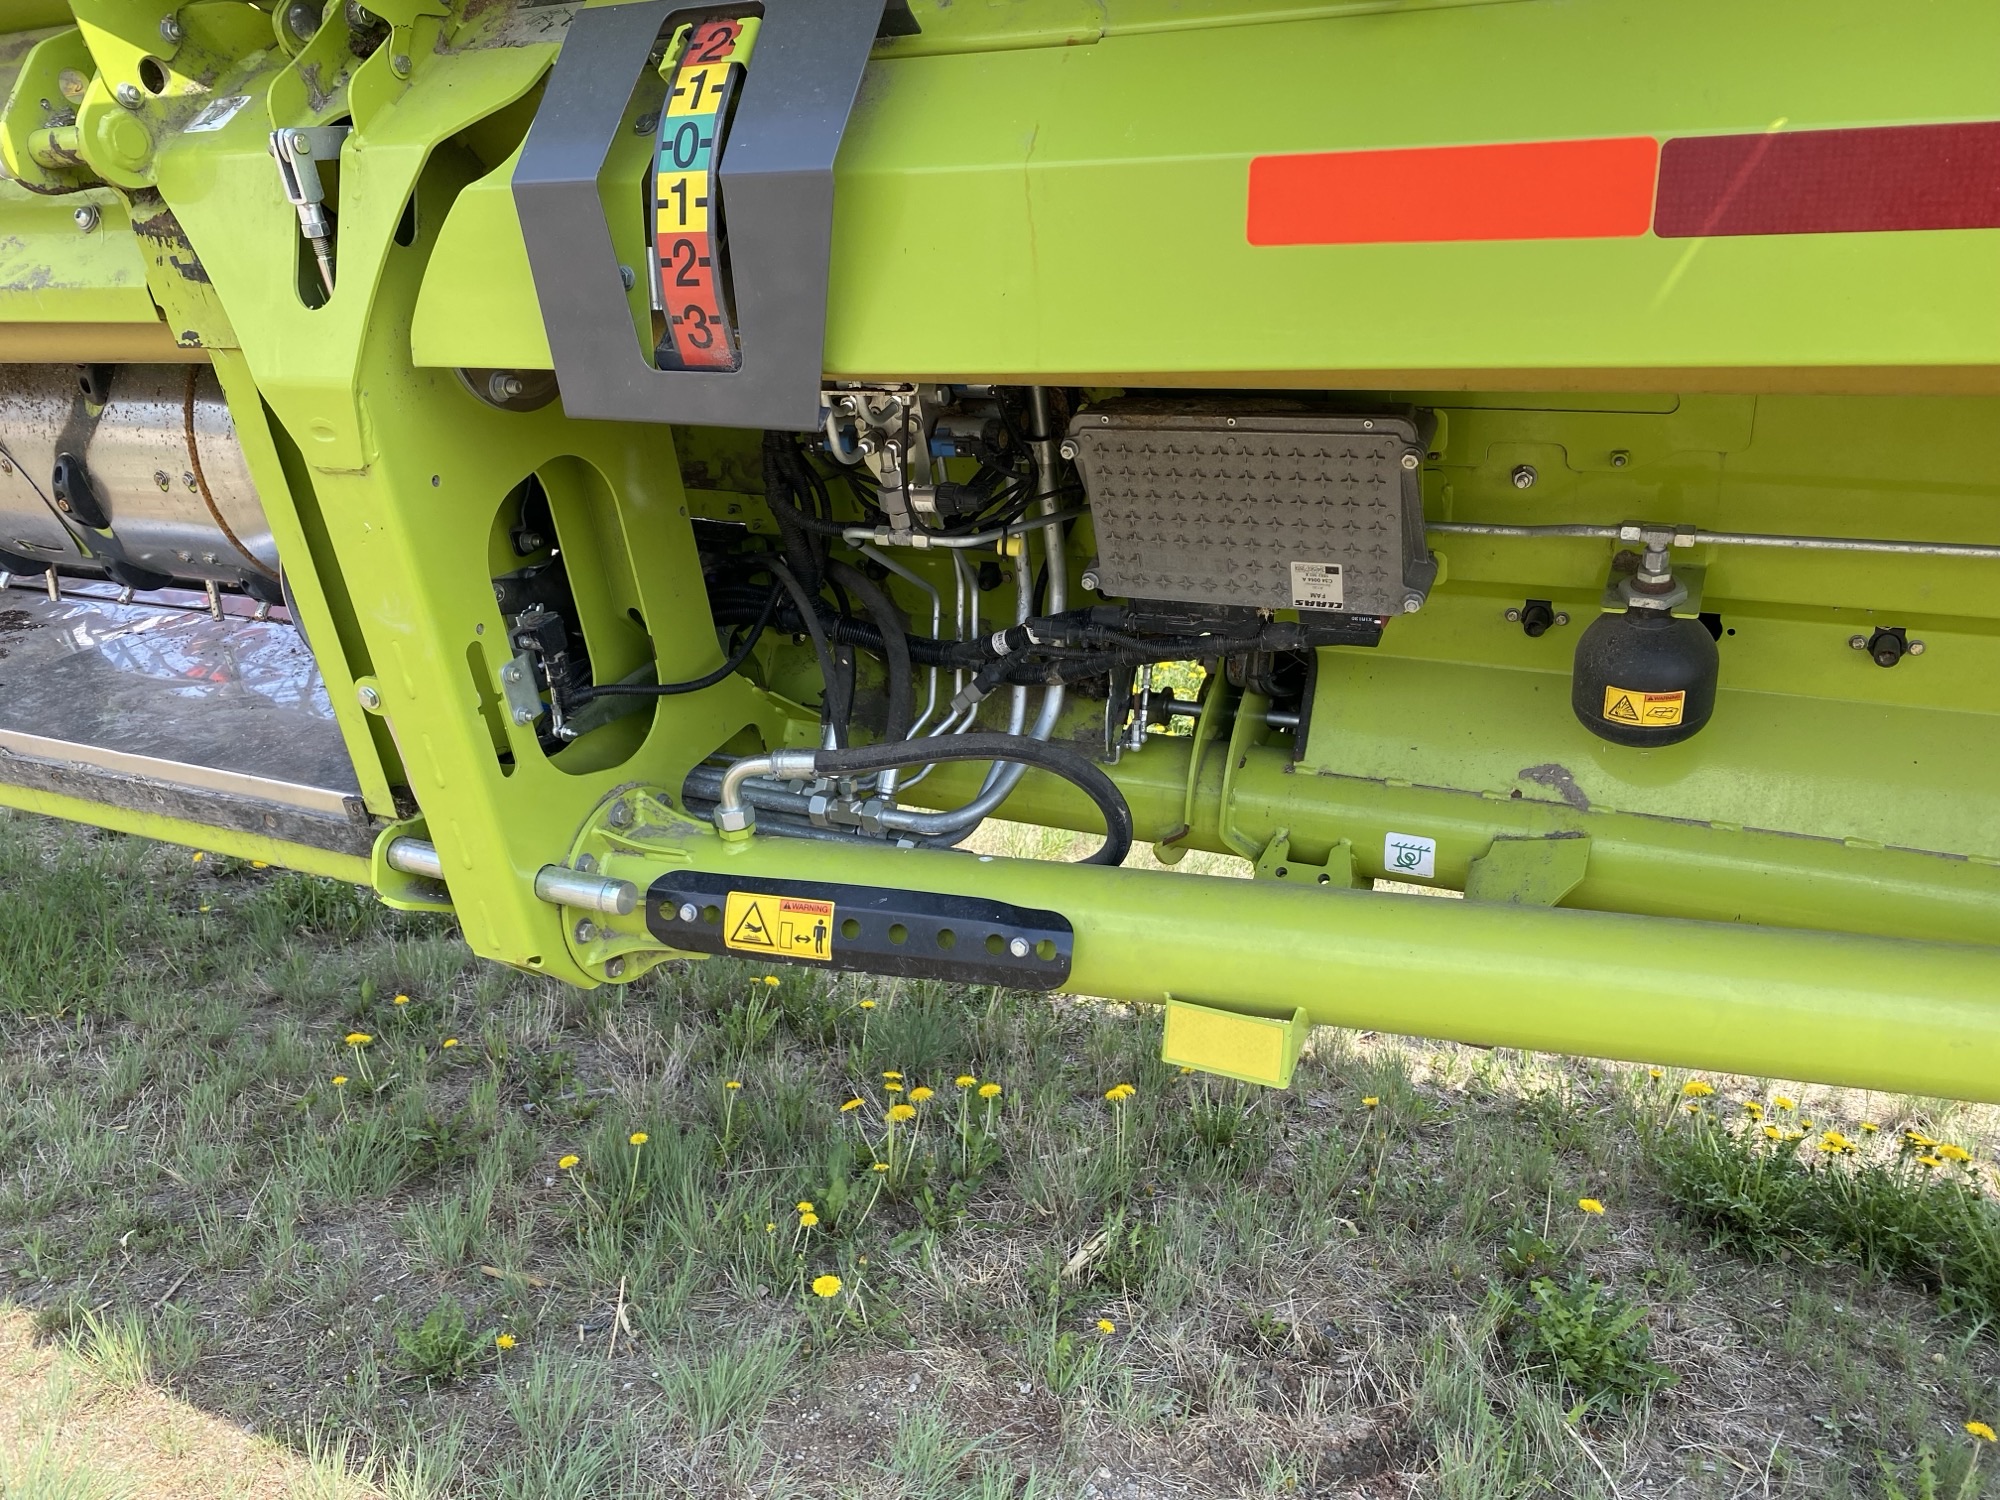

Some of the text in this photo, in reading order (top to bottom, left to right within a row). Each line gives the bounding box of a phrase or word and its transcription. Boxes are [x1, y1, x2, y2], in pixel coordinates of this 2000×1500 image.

[697, 27, 732, 62] 2
[690, 69, 708, 110] 1
[673, 121, 698, 169] 0
[670, 178, 687, 226] 1
[673, 238, 700, 288] 2
[683, 304, 713, 349] 3
[1295, 600, 1342, 608] CLAAS
[792, 903, 828, 913] WARNING
